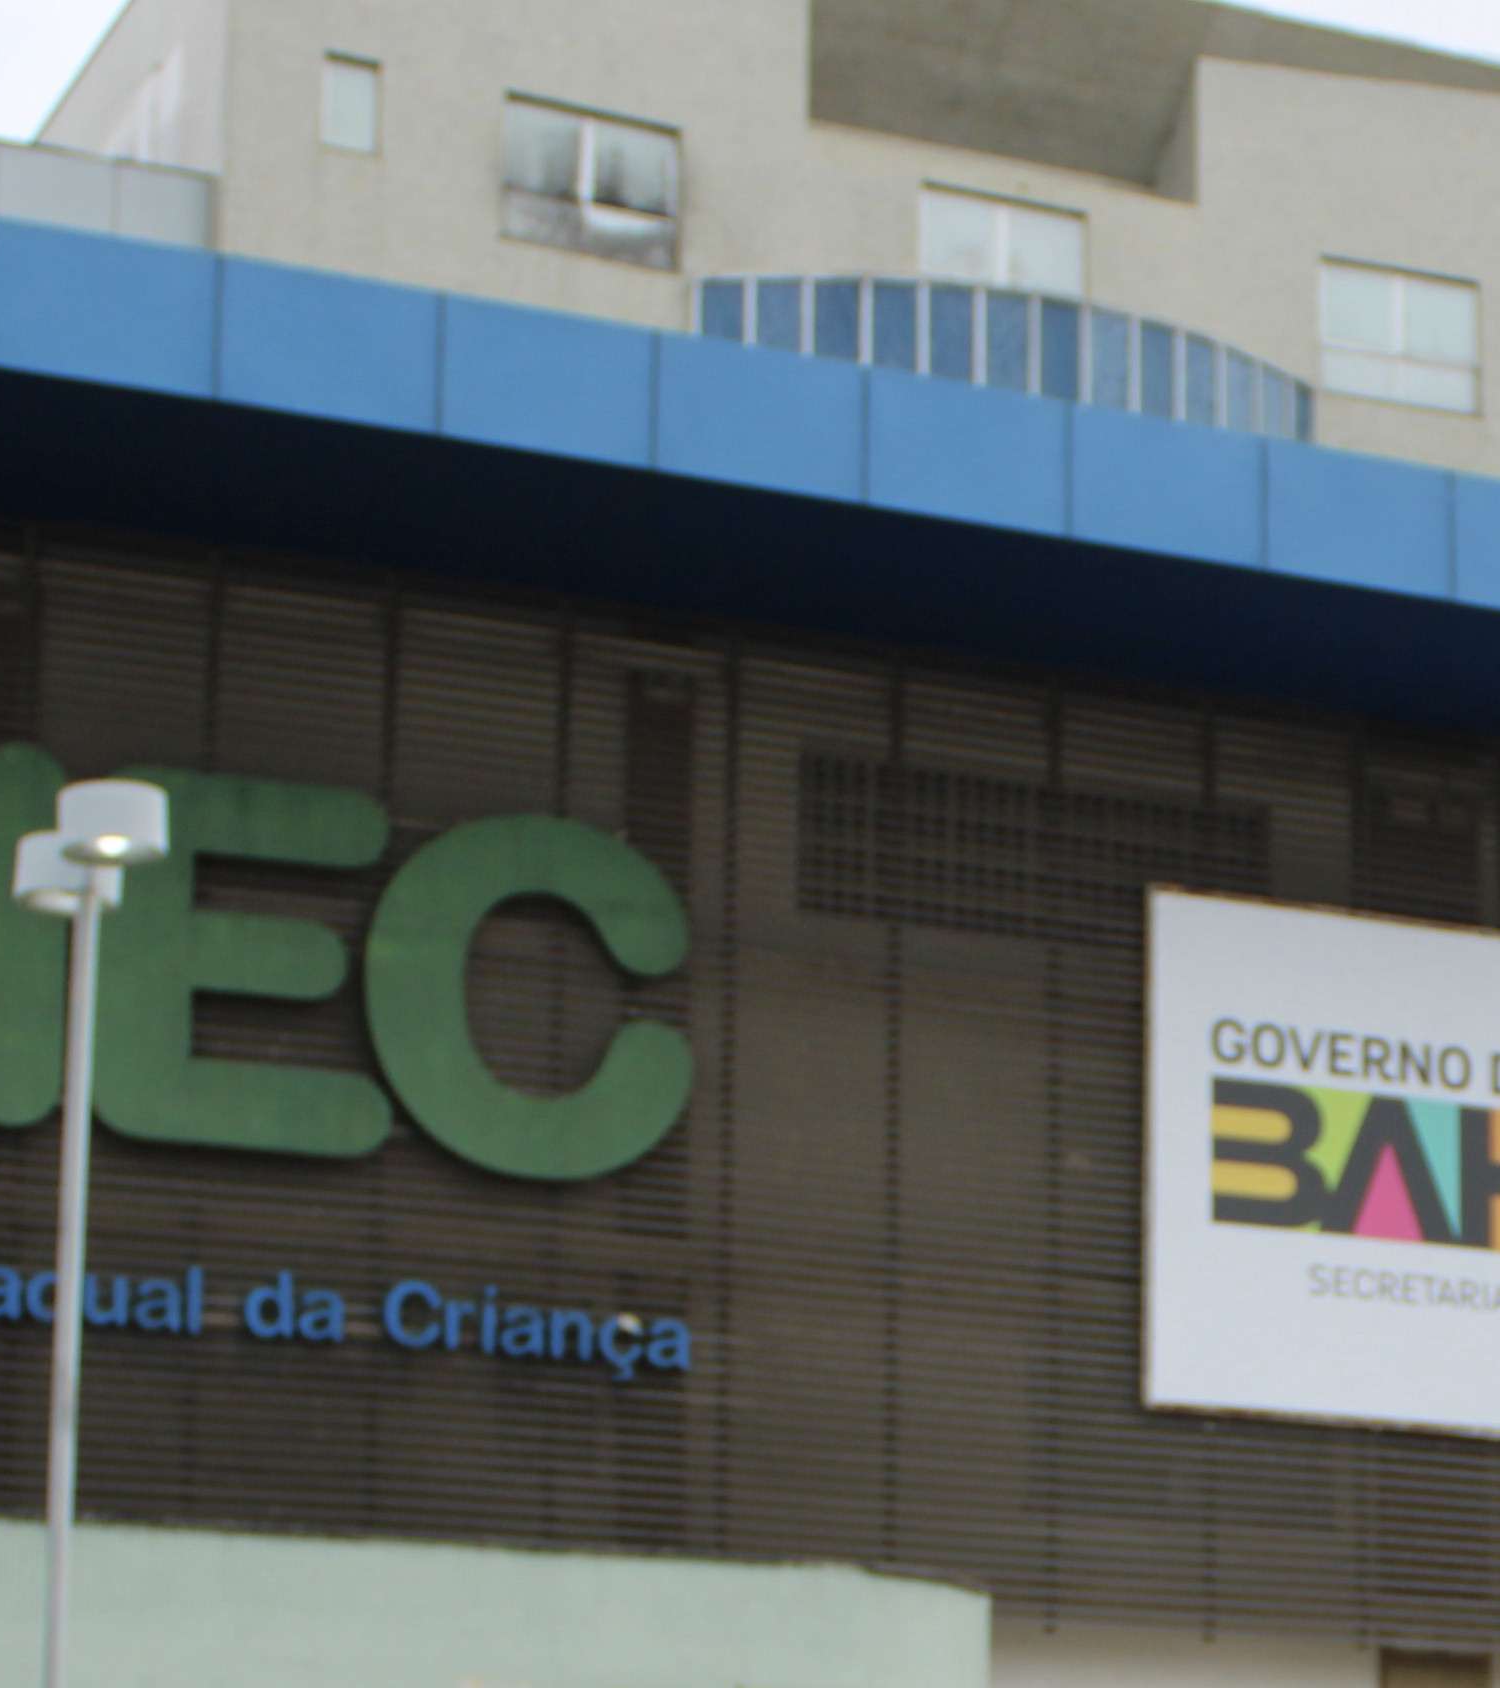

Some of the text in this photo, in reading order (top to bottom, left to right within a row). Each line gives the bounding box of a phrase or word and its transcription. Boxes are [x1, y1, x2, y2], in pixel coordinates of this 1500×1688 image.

[1211, 1018, 1471, 1091] GOVERNO
[243, 1267, 346, 1342] da
[383, 1279, 691, 1380] Criança
